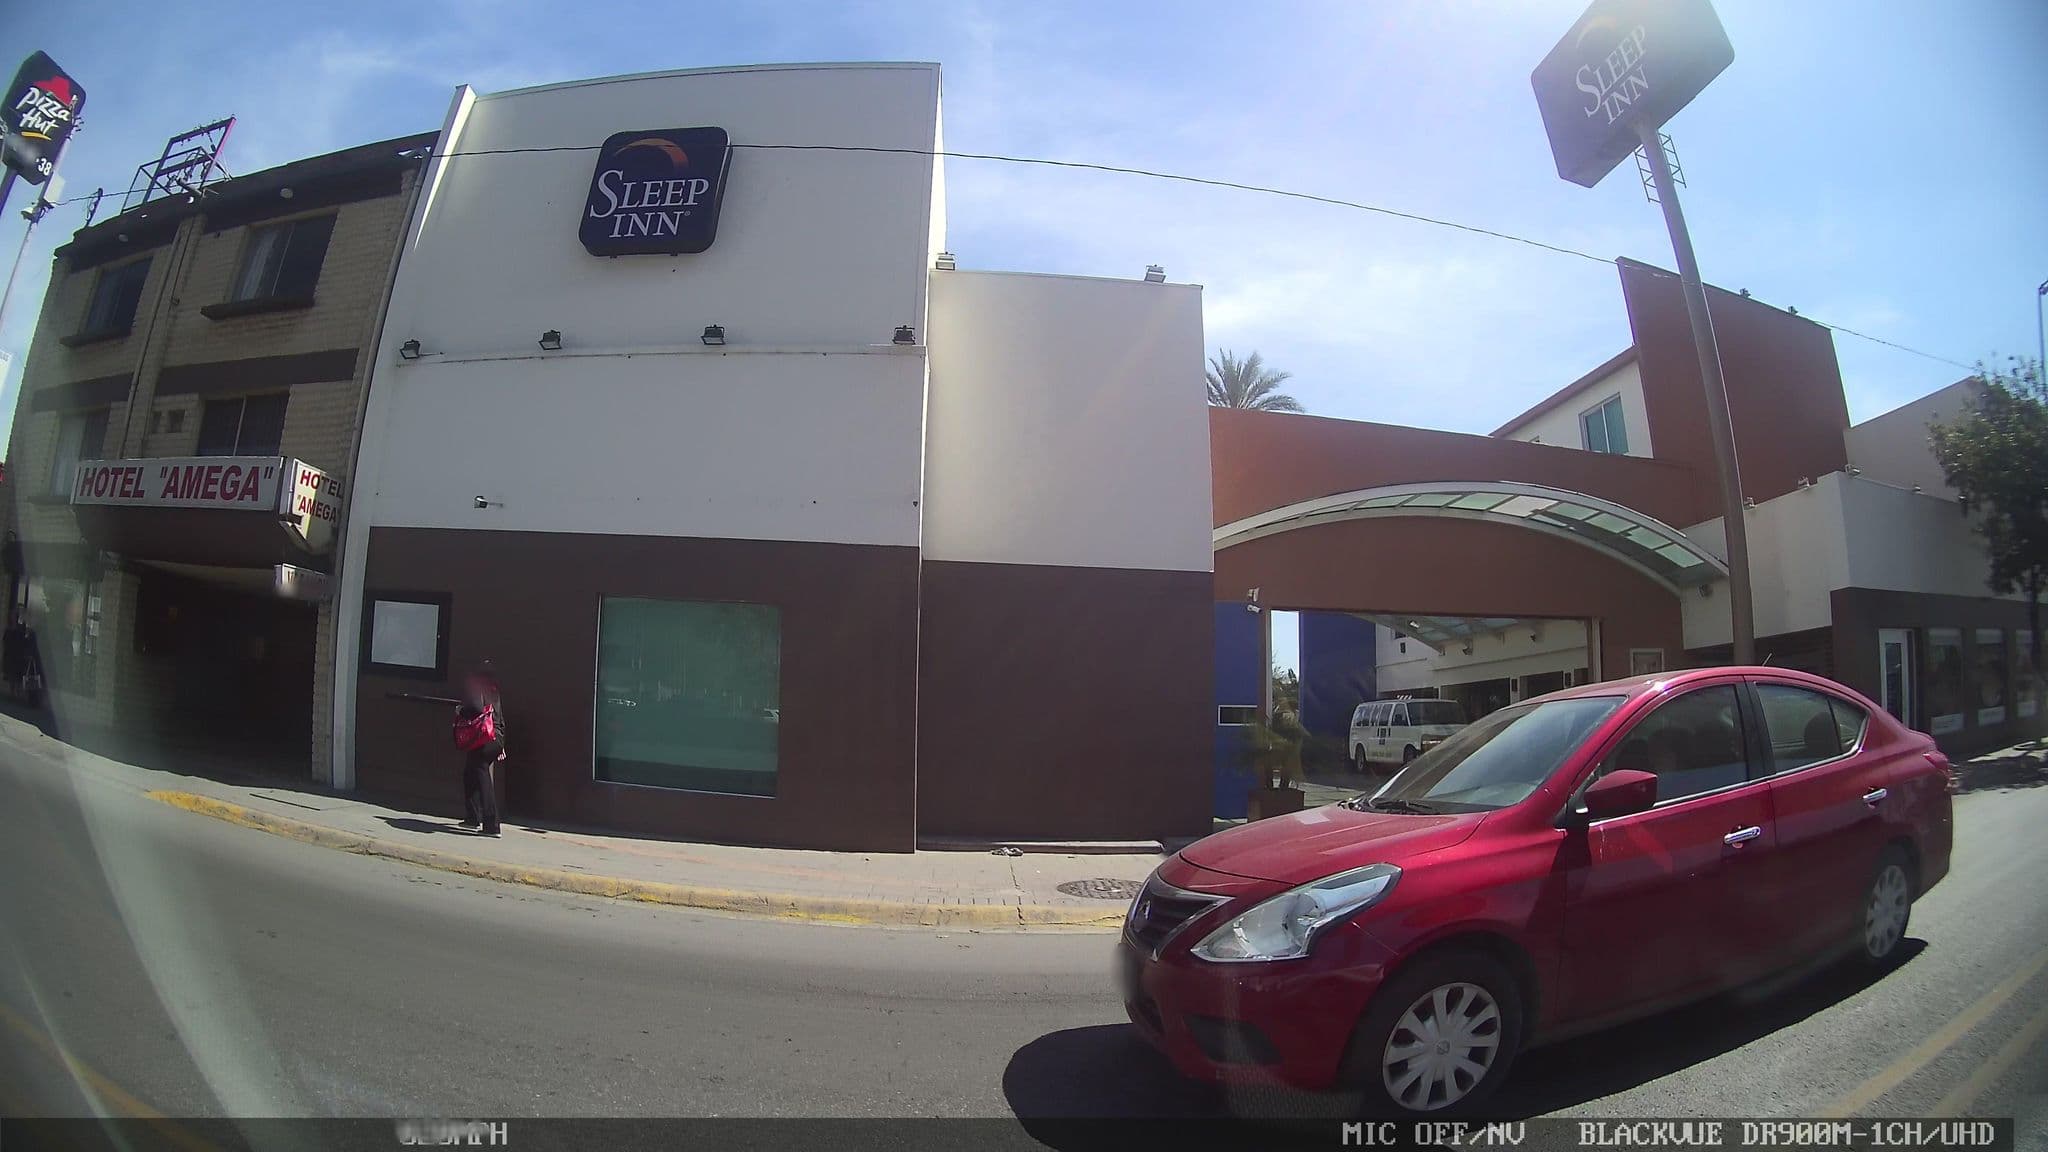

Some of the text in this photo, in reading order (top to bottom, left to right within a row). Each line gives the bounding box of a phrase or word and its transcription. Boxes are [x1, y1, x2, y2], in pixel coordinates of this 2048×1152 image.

[16, 86, 70, 121] Pizza
[1601, 64, 1649, 125] INN
[19, 108, 59, 135] Hut
[590, 169, 709, 218] SLEEP
[79, 465, 274, 502] HOTEL "AMEGA"
[300, 470, 344, 499] HOTEL
